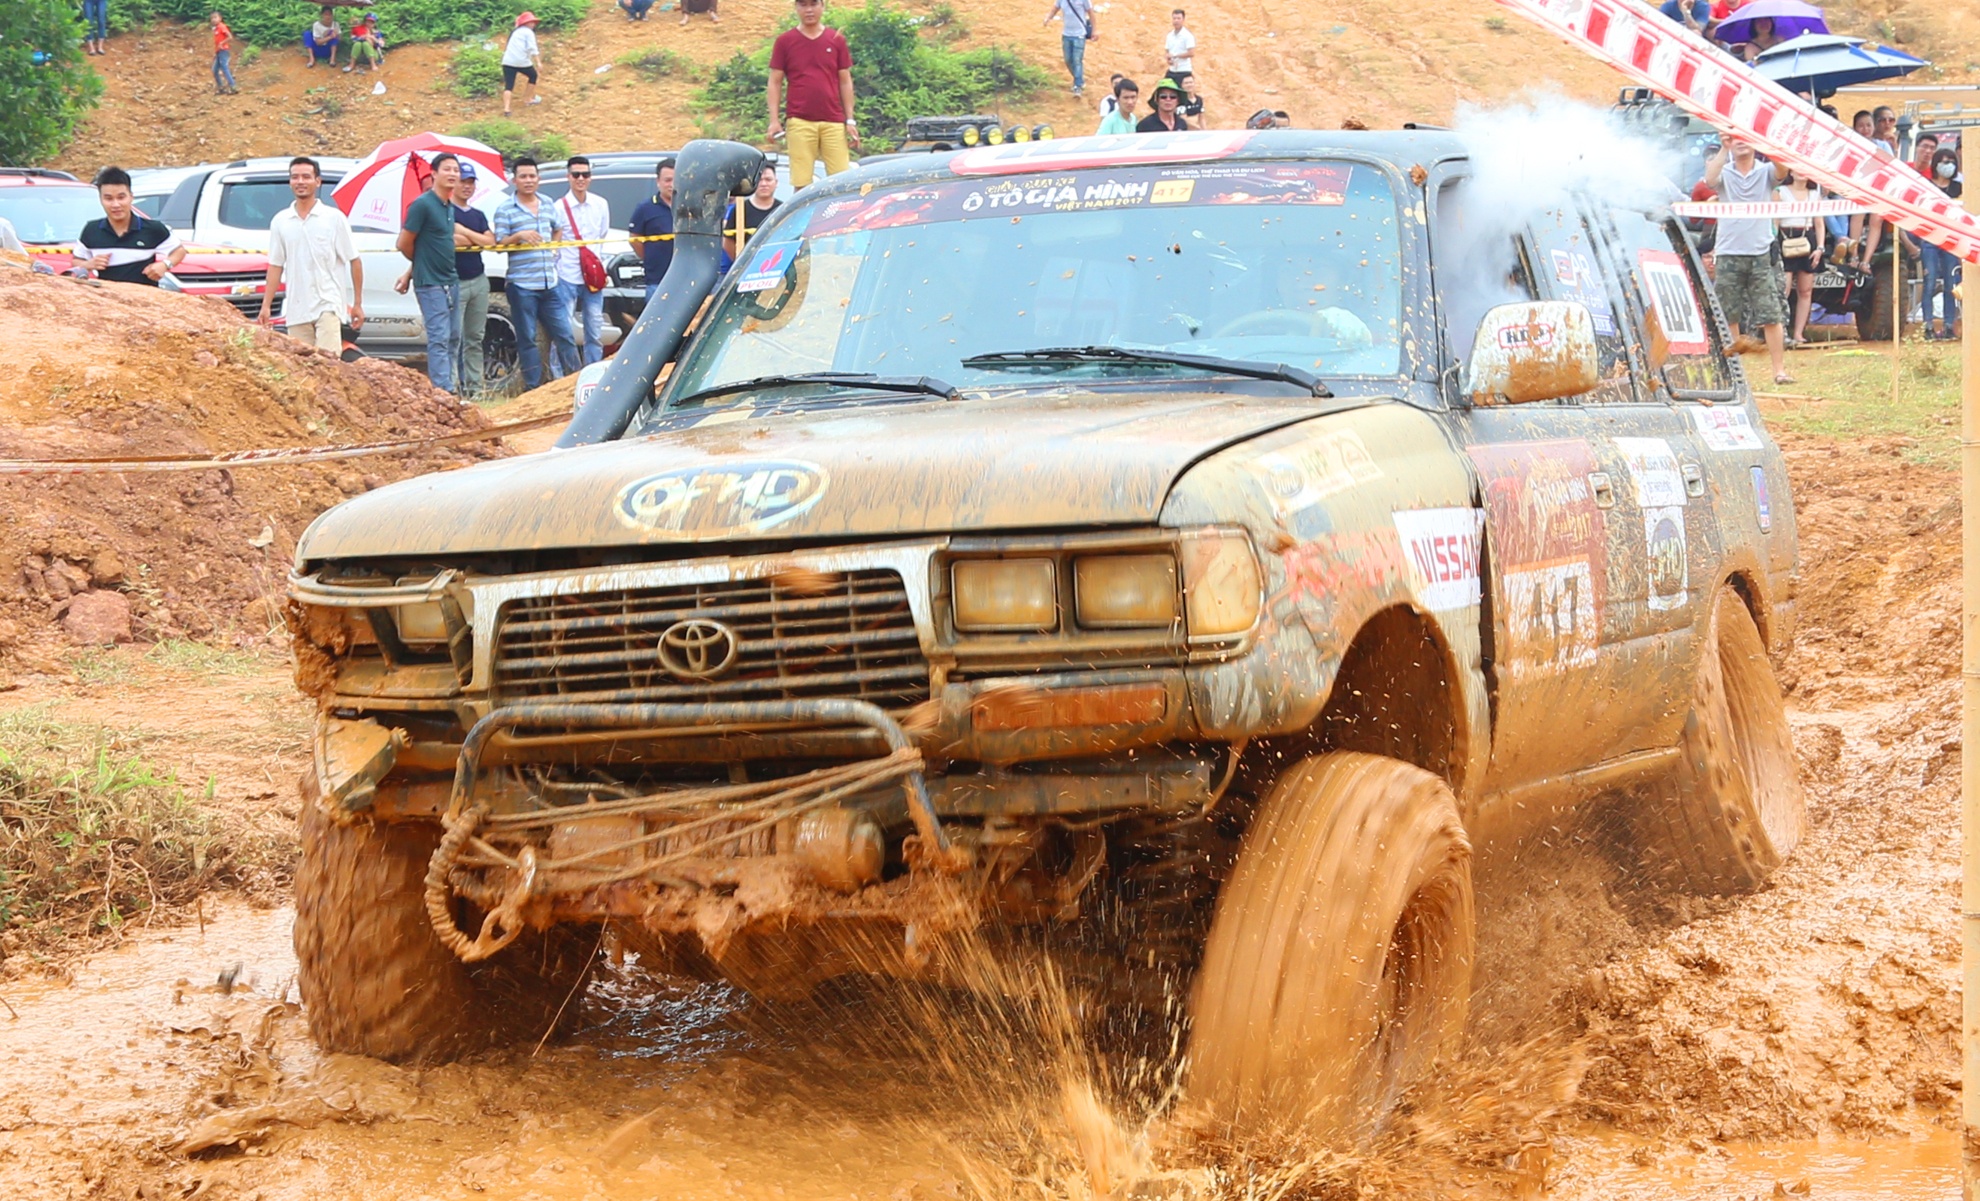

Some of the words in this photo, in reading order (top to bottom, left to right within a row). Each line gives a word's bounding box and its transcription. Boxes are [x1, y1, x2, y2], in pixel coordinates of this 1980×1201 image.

[962, 191, 985, 212] Ô
[988, 187, 1024, 208] TÔ
[1084, 178, 1149, 201] HÌNH
[1153, 186, 1191, 197] 417
